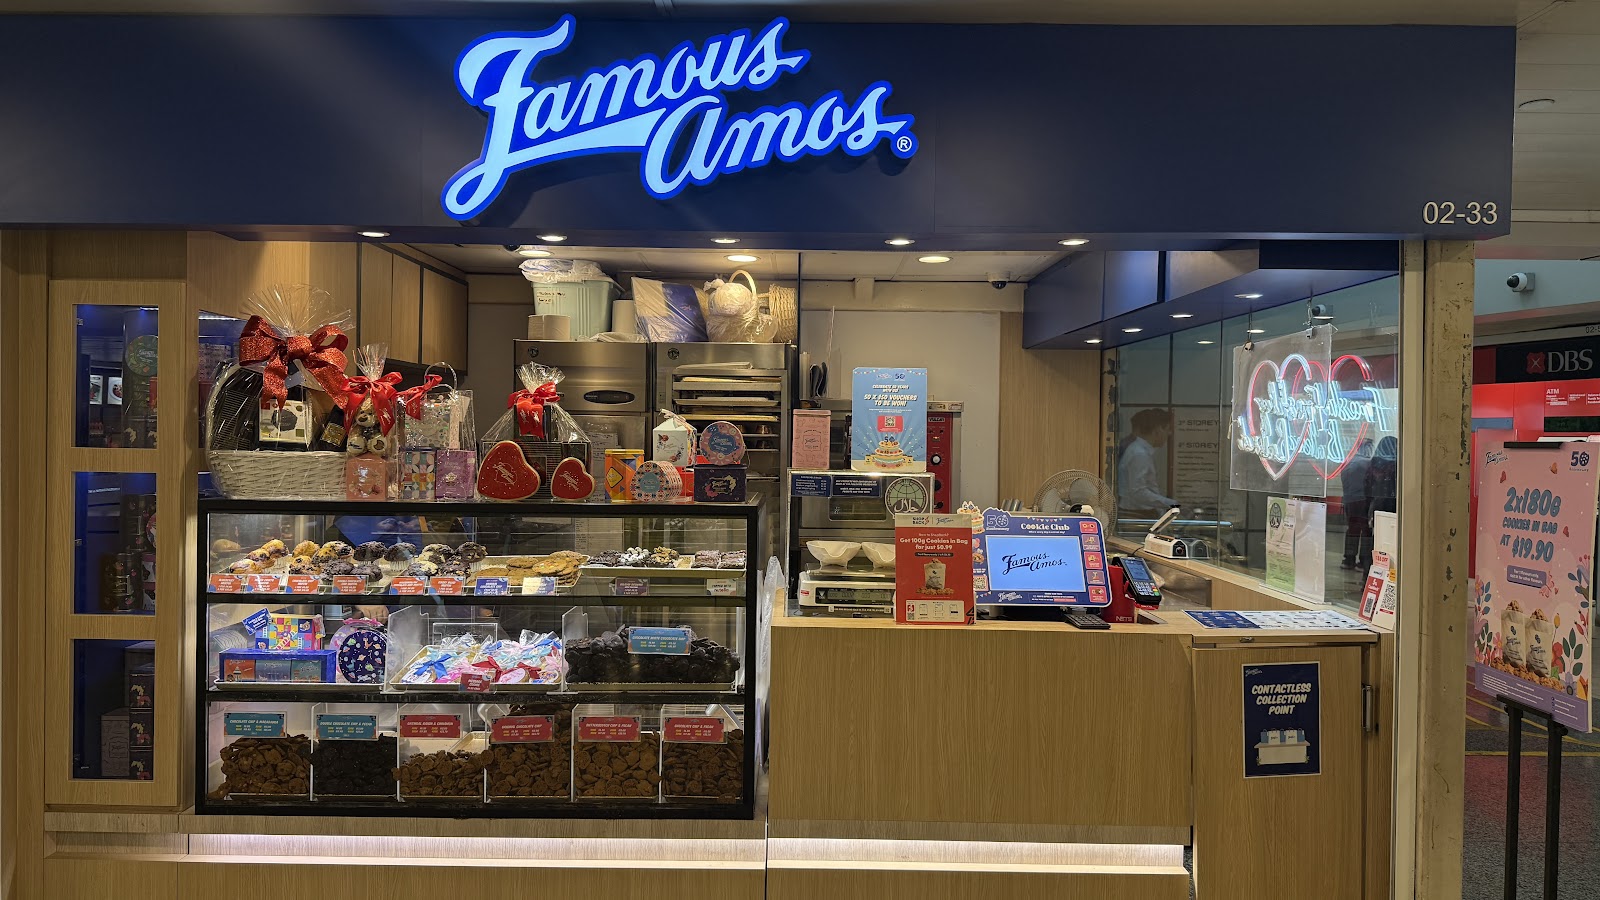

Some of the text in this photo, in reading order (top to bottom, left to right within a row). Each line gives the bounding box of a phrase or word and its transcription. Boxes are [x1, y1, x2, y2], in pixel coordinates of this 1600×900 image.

[444, 18, 803, 215] Famous
[645, 86, 908, 194] Amos
[1422, 201, 1498, 225] 02-33
[1547, 349, 1593, 373] DBS
[889, 394, 918, 402] VOUCHERS
[1570, 450, 1590, 467] 50
[1020, 523, 1071, 531] Cookie Club
[1503, 516, 1559, 535] COOKIES IN BAG
[1500, 534, 1555, 563] AT $19.90
[1002, 551, 1050, 576] Famous
[1029, 558, 1068, 572] Amos
[1251, 682, 1312, 695] CONTACTLESS
[1256, 694, 1308, 705] COLLECTION
[1268, 705, 1296, 715] POINT
